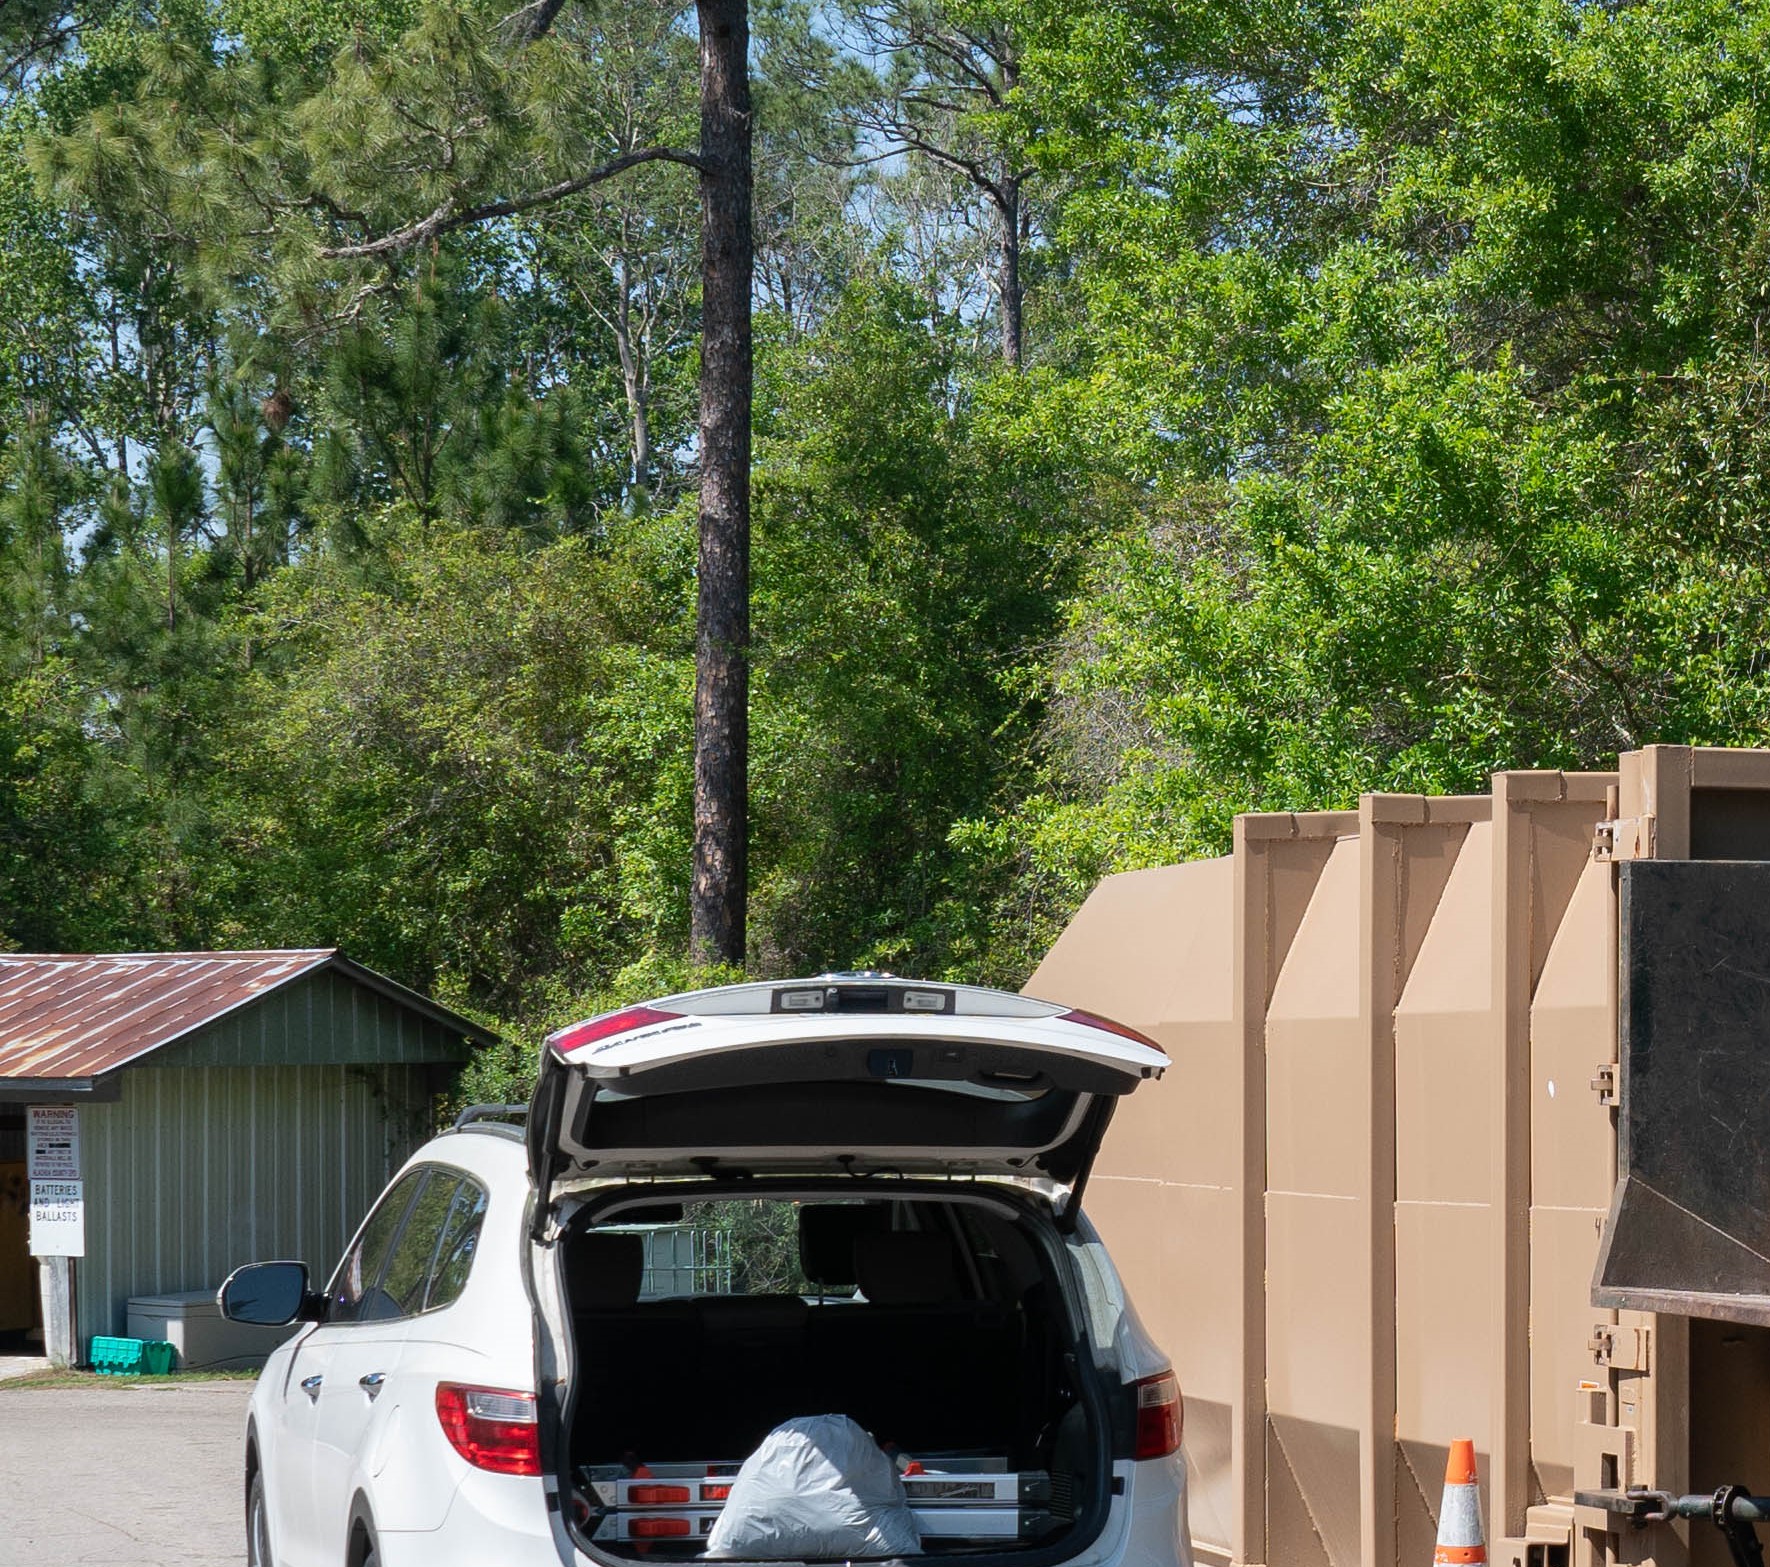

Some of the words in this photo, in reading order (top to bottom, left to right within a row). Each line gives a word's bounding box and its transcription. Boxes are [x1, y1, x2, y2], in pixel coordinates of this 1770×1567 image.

[32, 1110, 74, 1119] WARNING
[35, 1184, 77, 1196] BATTERIES
[33, 1198, 49, 1207] AND
[36, 1211, 77, 1222] BALLASTS
